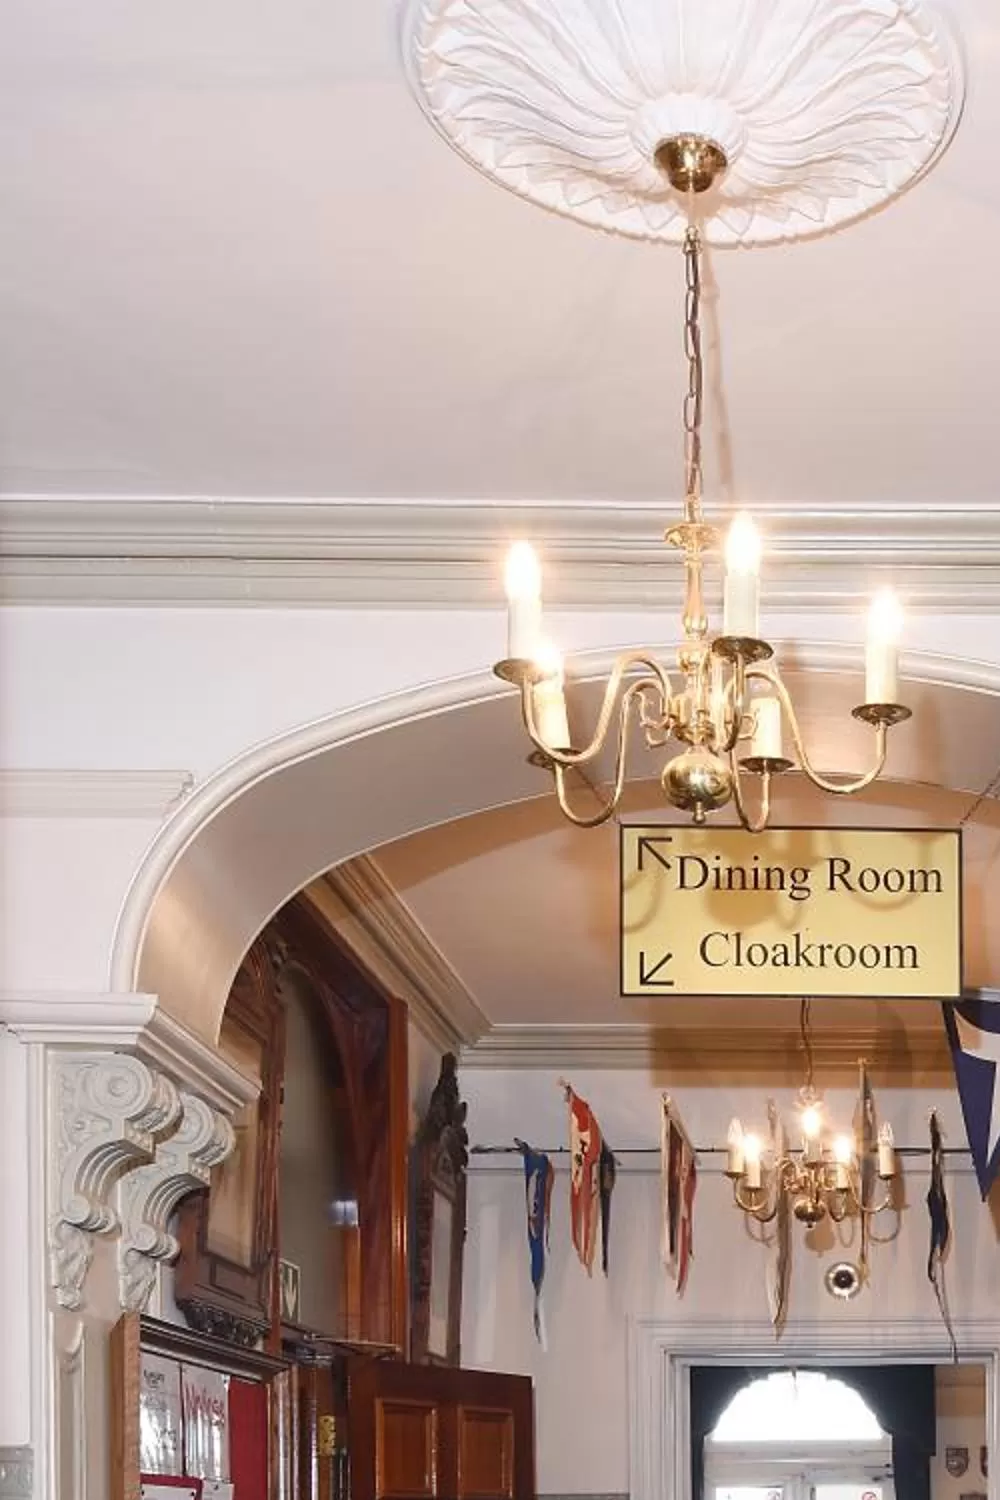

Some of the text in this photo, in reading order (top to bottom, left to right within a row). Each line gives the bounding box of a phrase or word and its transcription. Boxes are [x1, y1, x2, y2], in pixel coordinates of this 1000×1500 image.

[676, 855, 943, 901] Dining Room
[699, 931, 920, 970] Cloakroom
